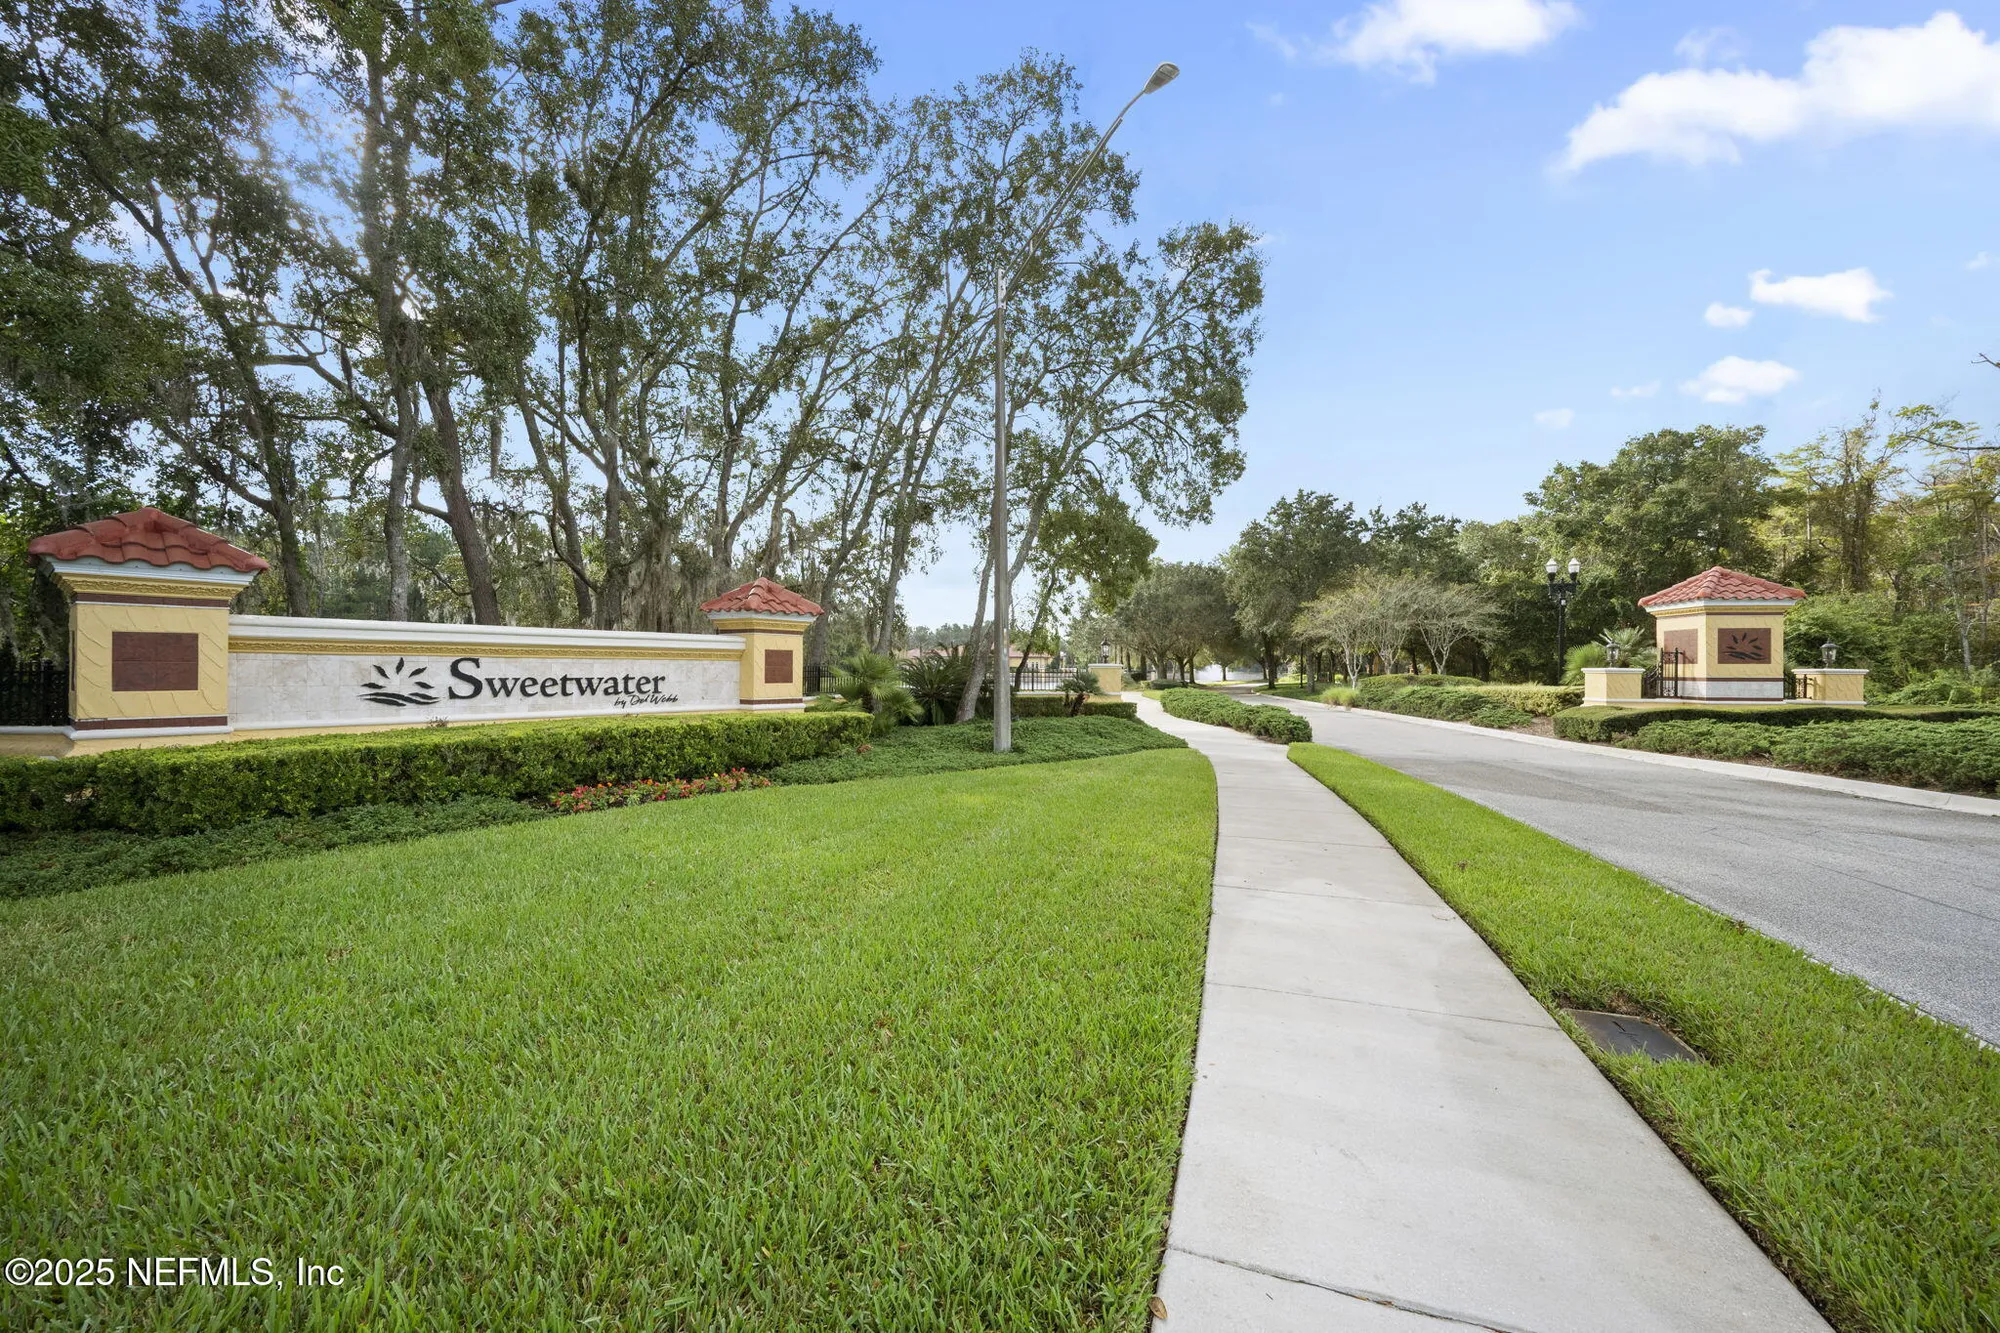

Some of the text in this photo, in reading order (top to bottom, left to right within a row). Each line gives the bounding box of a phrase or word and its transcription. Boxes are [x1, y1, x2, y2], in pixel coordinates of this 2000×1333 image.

[448, 657, 665, 699] Sweetwater
[614, 694, 678, 709] by Del Webb
